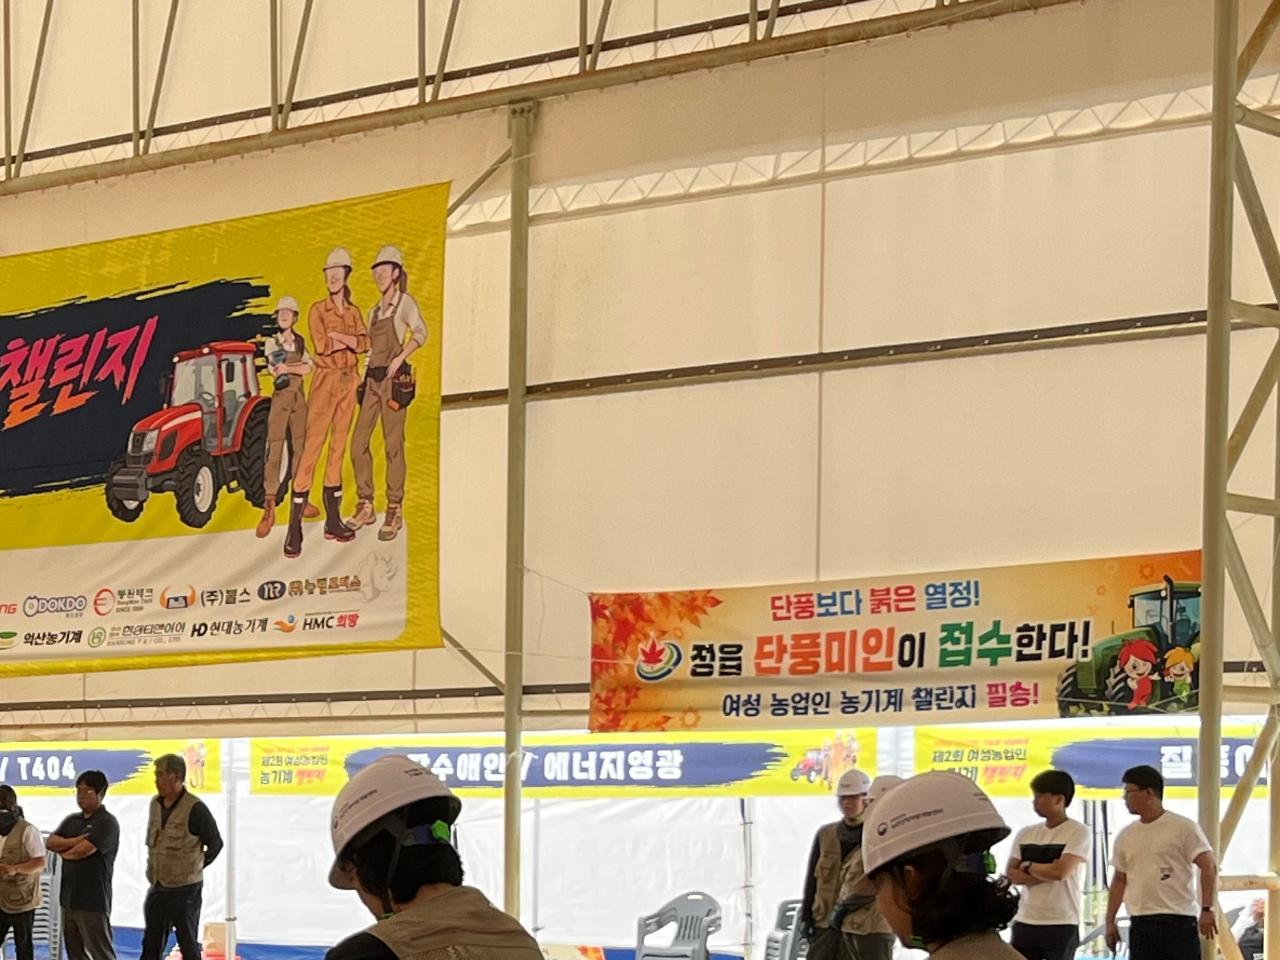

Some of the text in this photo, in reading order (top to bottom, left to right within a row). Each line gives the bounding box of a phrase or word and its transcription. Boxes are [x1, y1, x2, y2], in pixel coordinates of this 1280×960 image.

[769, 580, 981, 623] 단풍보다 붉은 열정!
[209, 618, 269, 637] 현대농기계
[302, 615, 335, 631] HMC
[752, 626, 928, 677] 단풍미인이
[937, 619, 1092, 670] 접수한다!
[721, 681, 1040, 719] 여성 농업인 농기계 챌린지 필승!
[16, 755, 77, 781] T404
[543, 749, 684, 781] 에너지영광
